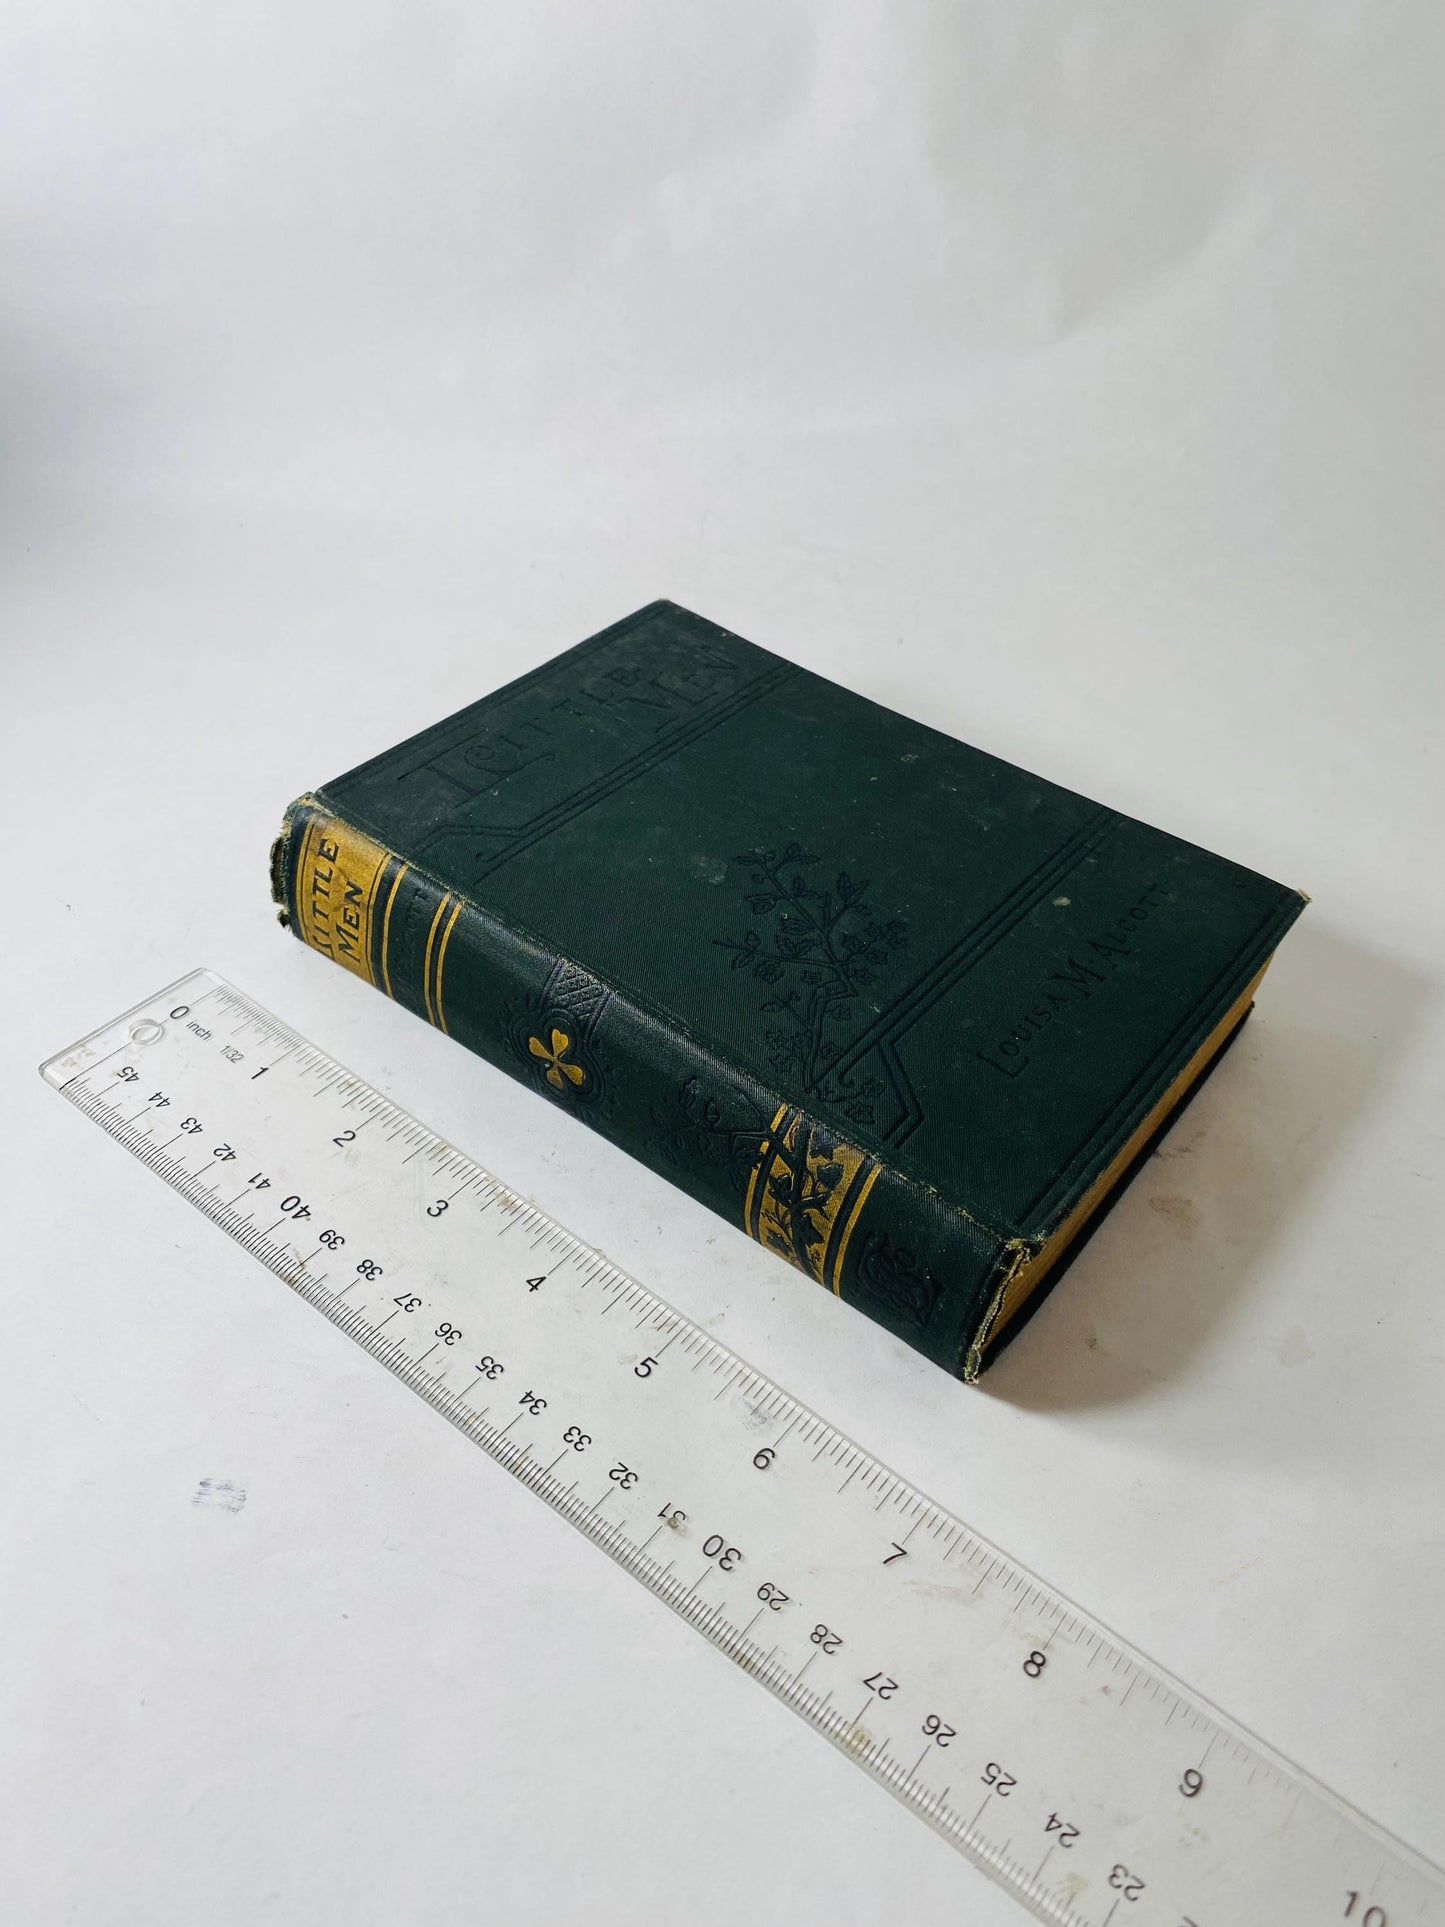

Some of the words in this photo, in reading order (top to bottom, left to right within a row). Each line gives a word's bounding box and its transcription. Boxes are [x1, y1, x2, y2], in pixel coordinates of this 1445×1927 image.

[336, 877, 363, 963] MEN
[185, 1021, 212, 1041] inch
[219, 1045, 245, 1064] 1/32
[116, 1066, 140, 1083] 45
[147, 1091, 171, 1108] 44
[180, 1117, 204, 1136] 43
[212, 1142, 237, 1163] 42
[247, 1171, 272, 1190] 41
[280, 1195, 312, 1222] 40
[318, 1229, 346, 1252] 39
[356, 1258, 384, 1282] 38
[393, 1292, 423, 1313] 37
[434, 1322, 463, 1347] 36
[475, 1355, 505, 1381] 35
[169, 1005, 191, 1020] 0
[250, 1066, 270, 1080] 1
[332, 1129, 357, 1148] 2
[426, 1199, 450, 1218] 3
[525, 1275, 547, 1293] 4
[634, 1356, 659, 1379] 5
[752, 1447, 776, 1471] 6
[882, 1542, 908, 1565] 7
[1022, 1650, 1047, 1679] 8
[1179, 1768, 1204, 1798] 9
[518, 1390, 548, 1416] 34
[562, 1425, 593, 1453] 33
[608, 1461, 639, 1490] 32
[657, 1502, 687, 1529] 31
[702, 1534, 742, 1572] 30
[756, 1582, 790, 1611] 29
[809, 1623, 844, 1656] 28
[863, 1671, 899, 1701] 27
[921, 1714, 957, 1748] 26
[980, 1762, 1018, 1797] 25
[1044, 1812, 1081, 1849] 24
[1108, 1864, 1146, 1902] 23
